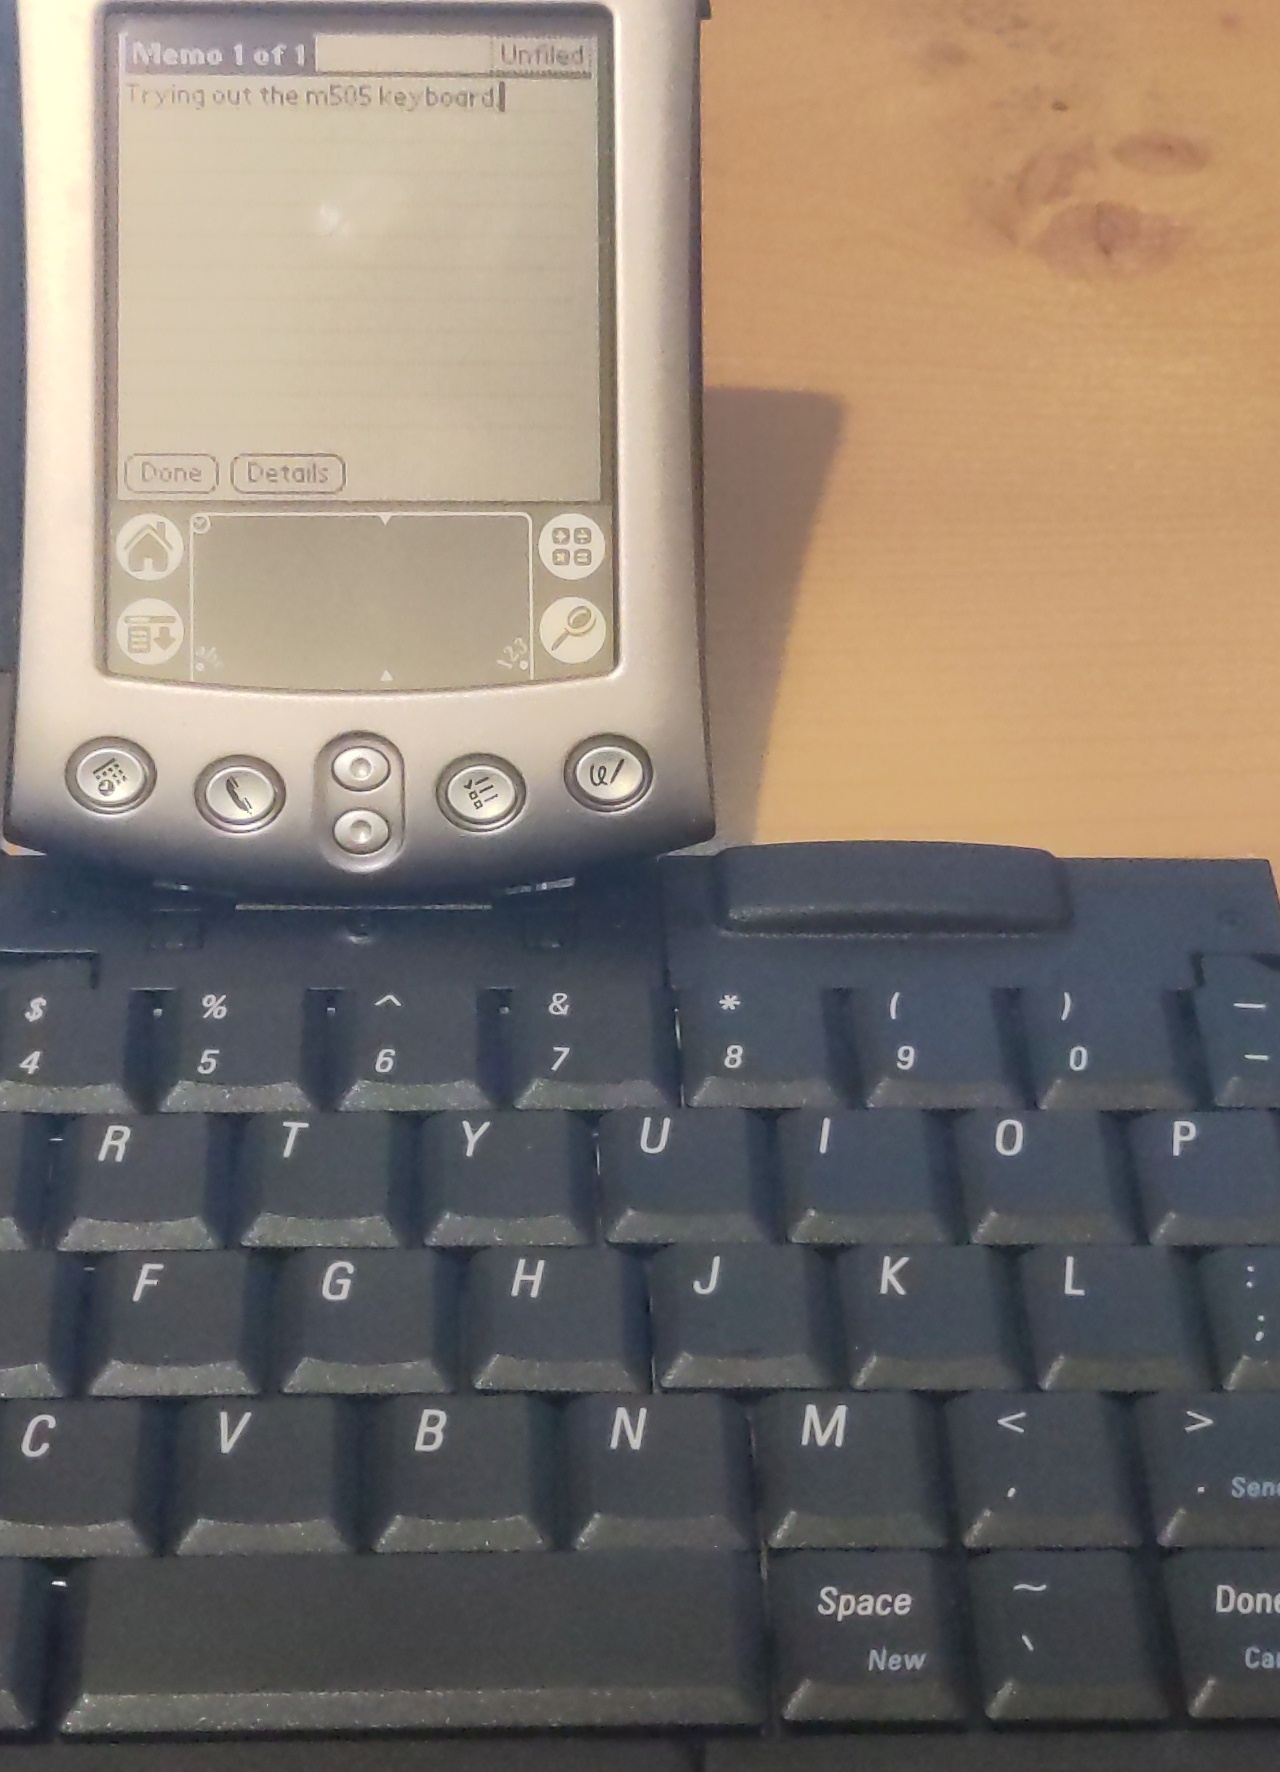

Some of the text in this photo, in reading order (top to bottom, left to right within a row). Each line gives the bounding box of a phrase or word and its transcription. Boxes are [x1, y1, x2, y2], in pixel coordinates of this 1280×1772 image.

[132, 41, 305, 67] Memo 1 of 1
[500, 43, 584, 66] Unfiled
[126, 83, 206, 110] Trying
[212, 86, 252, 106] out
[259, 84, 298, 107] the
[305, 84, 372, 107] m505
[140, 461, 203, 483] Done
[247, 461, 329, 483] Details
[25, 997, 47, 1022] $
[202, 994, 227, 1019] %
[549, 993, 569, 1015] &
[890, 992, 899, 1019] (
[1062, 993, 1071, 1020] )
[20, 1051, 41, 1074] 4
[198, 1049, 219, 1074] 5
[375, 1049, 395, 1073] 6
[552, 1047, 570, 1071] 7
[724, 1045, 743, 1068] 8
[897, 1046, 915, 1070] 9
[1070, 1046, 1087, 1071] 0
[98, 1125, 131, 1162] R
[283, 1121, 309, 1157] T
[462, 1121, 490, 1157] Y
[640, 1117, 671, 1153] U
[820, 1118, 830, 1153] I
[996, 1119, 1023, 1156] O
[1173, 1121, 1197, 1156] P
[133, 1264, 164, 1301] F
[322, 1261, 354, 1300] G
[512, 1259, 545, 1297] H
[694, 1256, 720, 1294] J
[881, 1256, 909, 1295] K
[1065, 1256, 1084, 1295] L
[220, 1412, 251, 1453] V
[415, 1409, 447, 1451] B
[611, 1407, 647, 1450] N
[802, 1404, 847, 1447] M
[998, 1412, 1026, 1433] <
[1185, 1411, 1213, 1431] >
[22, 1414, 56, 1457] C
[818, 1587, 912, 1621] Space
[869, 1648, 926, 1671] New
